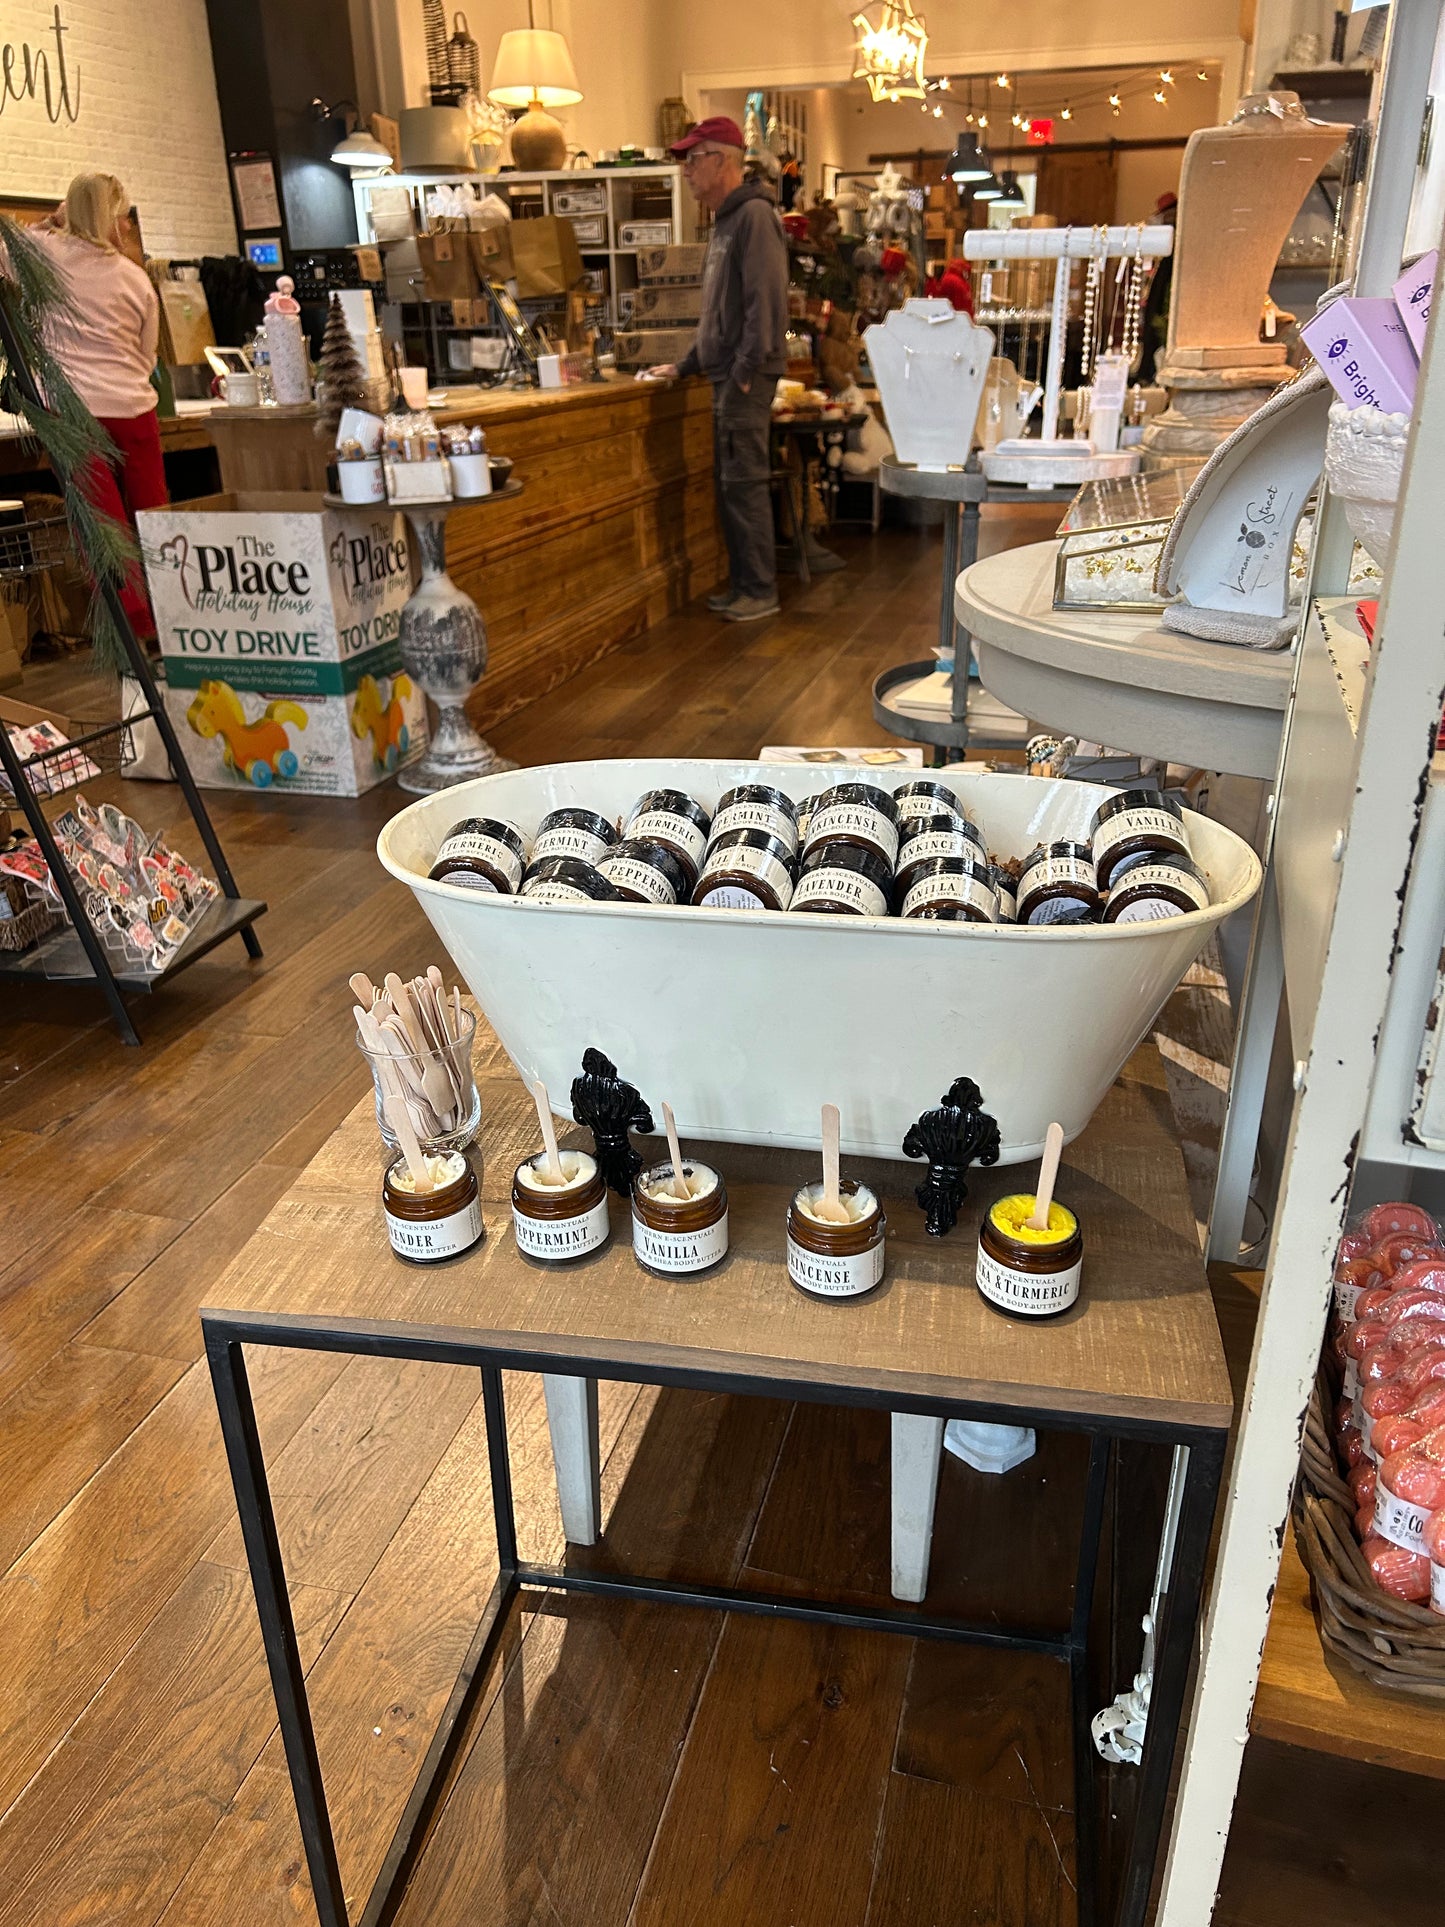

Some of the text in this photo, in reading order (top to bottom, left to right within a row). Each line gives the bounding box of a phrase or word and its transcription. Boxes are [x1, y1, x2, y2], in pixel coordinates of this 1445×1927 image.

[0, 4, 80, 123] ent
[1343, 360, 1384, 412] Bright
[1246, 485, 1278, 524] Street
[371, 522, 390, 543] The
[237, 535, 275, 557] The
[193, 545, 311, 596] Place
[348, 535, 408, 588] Place
[195, 585, 315, 622] Holiday House
[172, 627, 321, 657] TOY DRIVE
[340, 620, 371, 653] TOY
[641, 819, 696, 844] TURMERIC
[1126, 816, 1181, 836] VANILLA
[798, 879, 862, 899] LAVENDER
[539, 1216, 590, 1229] E-SCENTUALS
[573, 1235, 599, 1251] BUTTER
[664, 1228, 715, 1242] E-SCENTUALS
[426, 1243, 457, 1254] BUTTER
[644, 1236, 698, 1259] VANILLA
[697, 1249, 722, 1263] BUTTER
[979, 1261, 1070, 1300] KA & TURMERIC
[1000, 1270, 1056, 1285] E-SCENTUALS
[1030, 1301, 1062, 1310] BUTTER
